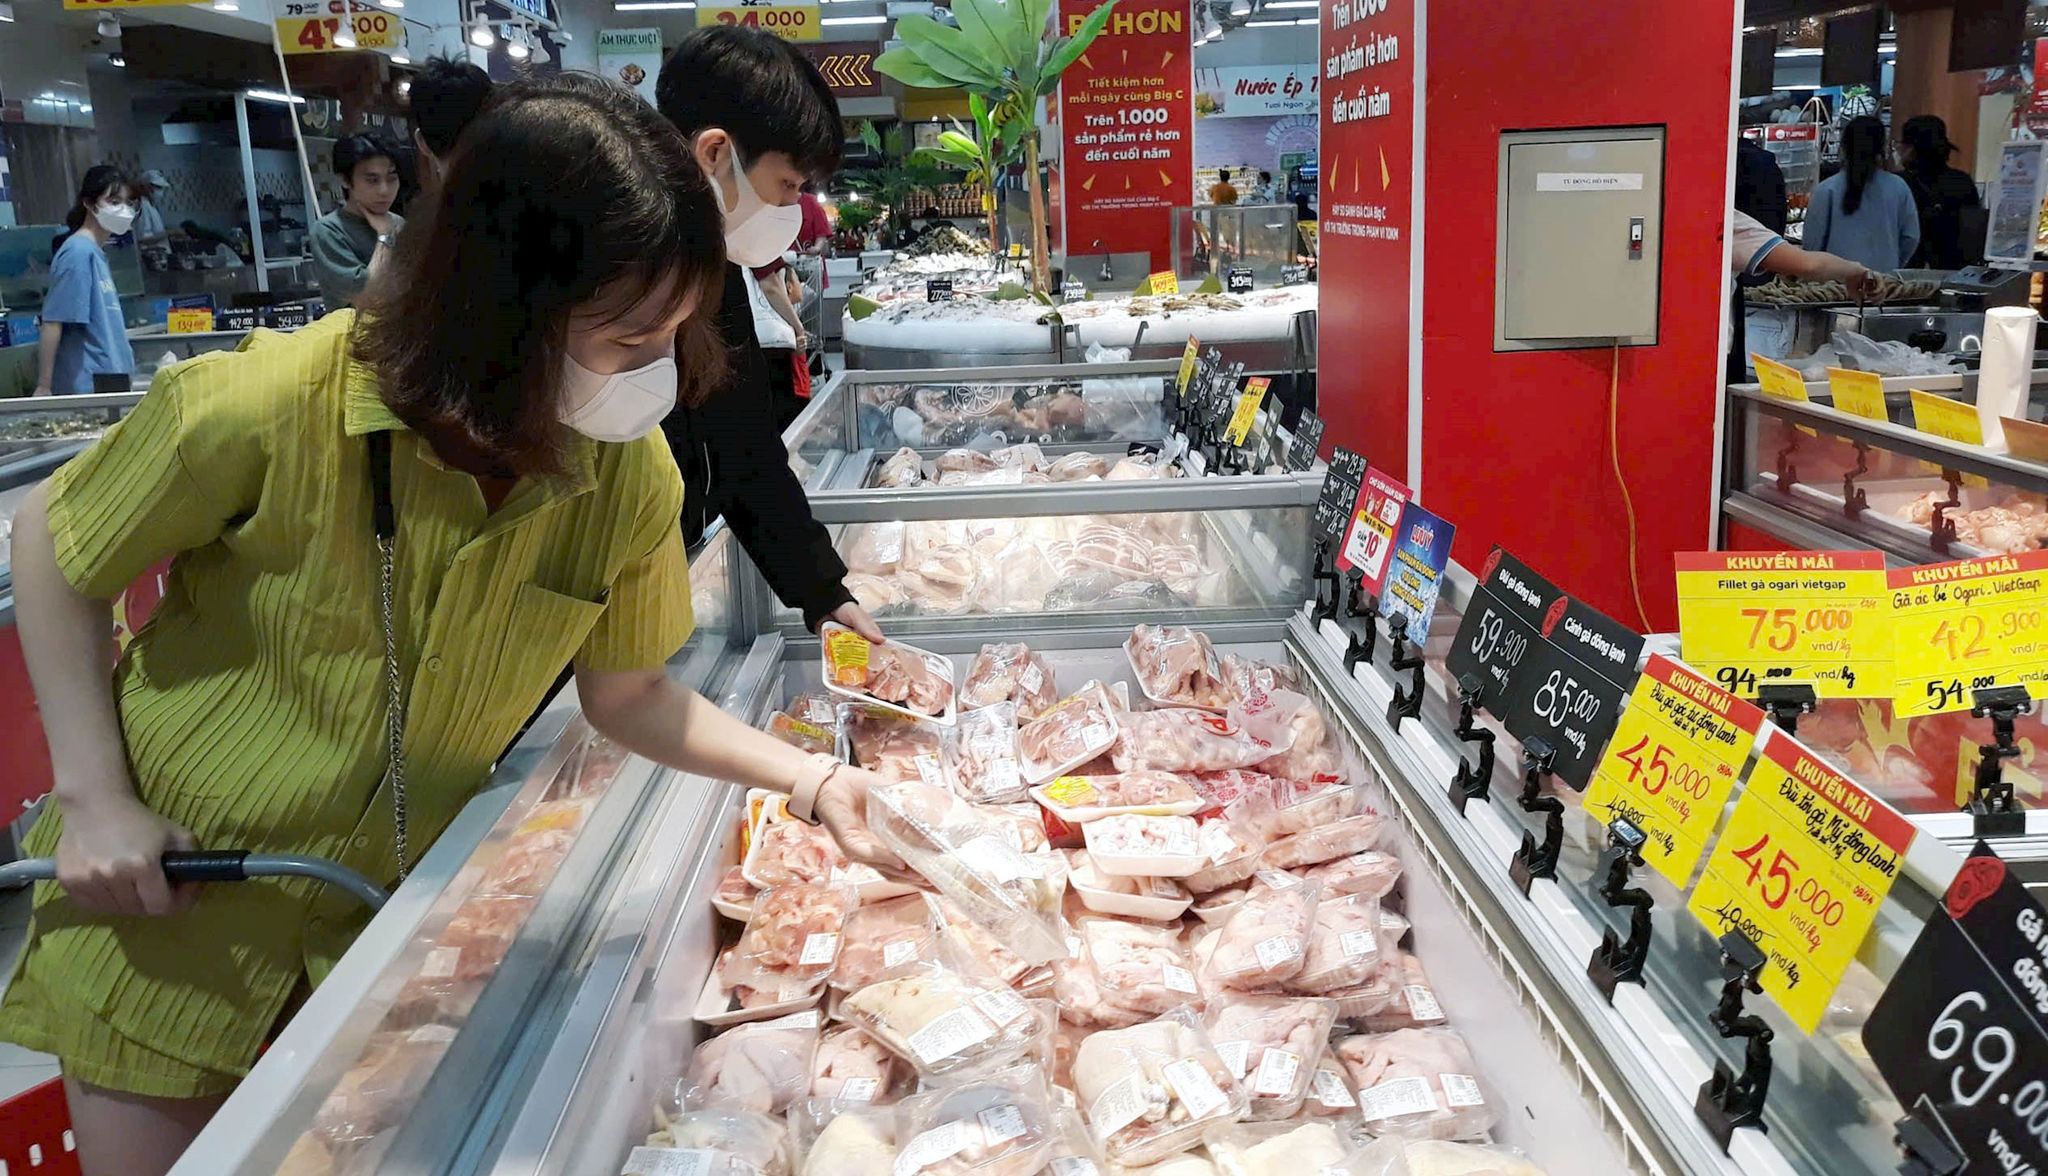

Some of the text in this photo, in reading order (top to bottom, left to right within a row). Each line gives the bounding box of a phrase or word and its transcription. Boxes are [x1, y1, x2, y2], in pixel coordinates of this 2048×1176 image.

[1114, 9, 1182, 35] HƠN
[1332, 1, 1350, 30] Trên
[1327, 31, 1398, 80] sản phẩm rẻ hơn
[1088, 77, 1165, 89] Tiết kiệm hơn
[1093, 92, 1120, 104] ngày
[1124, 91, 1151, 102] cùng
[1154, 90, 1173, 101] Big
[1175, 89, 1184, 99] C
[1235, 77, 1277, 96] Nước
[1283, 72, 1303, 99] Ép
[1085, 108, 1169, 126] Trên 1.000
[1283, 102, 1304, 110] Ngon
[1333, 85, 1390, 123] đến cuối năm
[1075, 128, 1180, 145] sản phẩm rẻ hơn
[1085, 147, 1171, 161] đến cuối năm
[1726, 551, 1834, 569] KHUYẾN MÃI
[1912, 557, 2019, 583] KHUYẾN MÃI
[1499, 568, 1541, 609] Đùi gà đông lạnh
[1718, 579, 1847, 591] Fillet gà ogari vietgap
[1915, 588, 1930, 605] ác
[1953, 584, 1986, 606] Ogari
[1993, 577, 2041, 594] VietGap
[1471, 608, 1527, 666] 59.900
[1565, 617, 1627, 665] Cánh gà đông lạnh
[1741, 609, 1853, 652] 75.000
[1533, 669, 1601, 728] 85.000
[1669, 670, 1732, 715] KHUYẾN MÃI
[1926, 675, 1995, 710] 54.000
[1564, 726, 1587, 760] vnd/kg
[1697, 711, 1718, 740] đông
[1716, 721, 1737, 745] lạnh
[1616, 734, 1710, 800] 45.000
[1794, 757, 1873, 822] KHUYẾN MÃI
[1666, 794, 1690, 824] vnd/kg
[1650, 826, 1675, 857] vnd/kg
[1779, 777, 1800, 803] Đùi
[1806, 808, 1829, 826] gà
[1826, 814, 1850, 843] Mỹ
[1842, 829, 1871, 863] đông
[1868, 844, 1897, 878] lạnh
[1732, 834, 1843, 926] 45.000
[1717, 899, 1764, 942] 49.000
[1789, 912, 1822, 953] vnd/kg
[1770, 948, 1801, 989] vnd/kg
[1928, 991, 2048, 1151] 69.00
